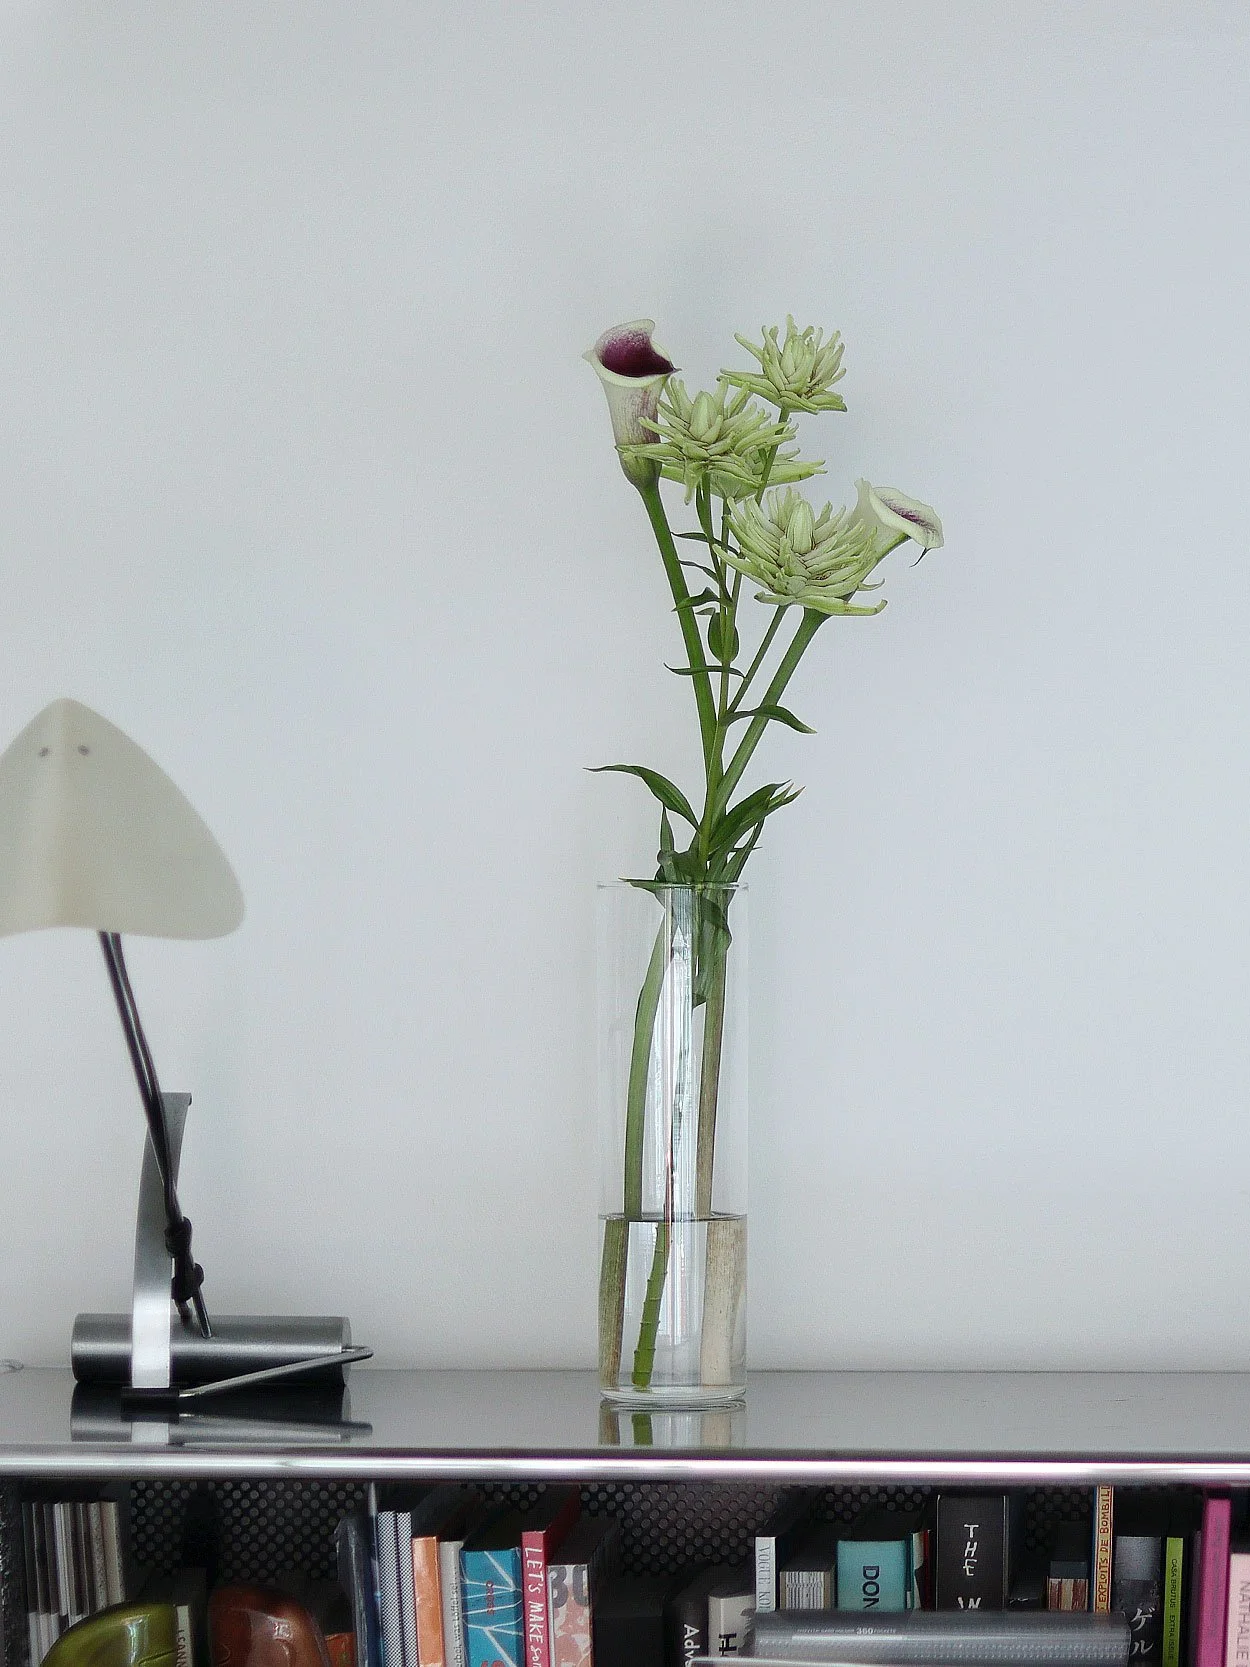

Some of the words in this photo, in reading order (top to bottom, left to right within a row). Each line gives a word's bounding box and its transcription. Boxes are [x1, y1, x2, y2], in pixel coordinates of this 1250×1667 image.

[758, 1544, 771, 1584] VOGUE
[962, 1523, 979, 1576] THE
[1101, 1539, 1109, 1553] DE
[524, 1547, 543, 1593] LET'S
[1098, 1557, 1108, 1603] EXPLOITS
[1170, 1558, 1178, 1577] CASA
[1169, 1579, 1177, 1608] BRUTUS
[528, 1600, 543, 1643] MAKE
[1130, 1607, 1156, 1656] ゲル
[1168, 1615, 1176, 1637] EXTRA
[1167, 1639, 1175, 1661] ISSUE
